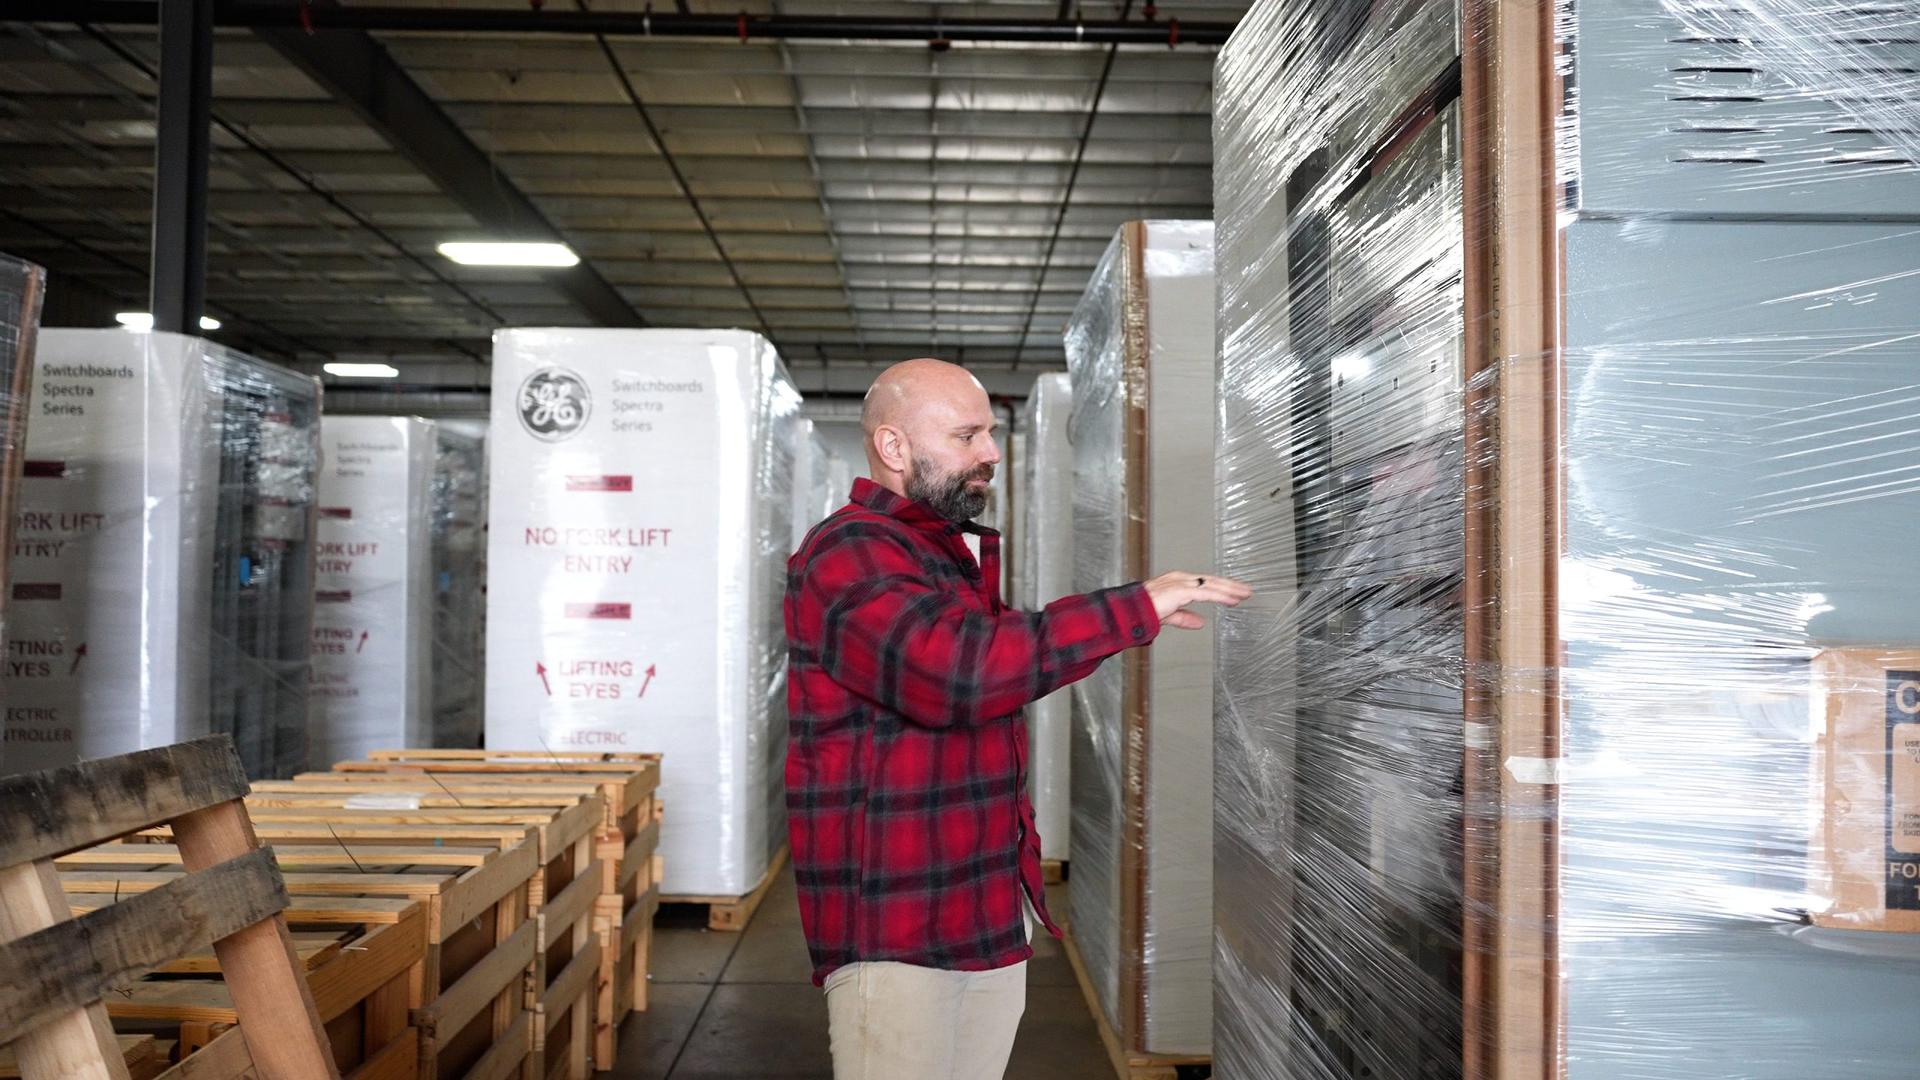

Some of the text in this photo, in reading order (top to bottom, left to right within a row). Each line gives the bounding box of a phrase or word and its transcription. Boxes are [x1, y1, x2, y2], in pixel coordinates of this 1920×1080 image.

[43, 364, 134, 379] Switchboards
[43, 382, 94, 398] Spectra
[611, 379, 704, 394] Switchboards
[43, 401, 84, 416] Series
[611, 400, 664, 414] Spectra
[611, 420, 653, 433] Series
[61, 513, 104, 532] LIFT
[525, 528, 672, 547] NO FORK LIFT
[349, 543, 377, 556] LIFT
[564, 555, 632, 573] ENTRY
[559, 660, 633, 677] LIFTING
[569, 683, 621, 699] EYES
